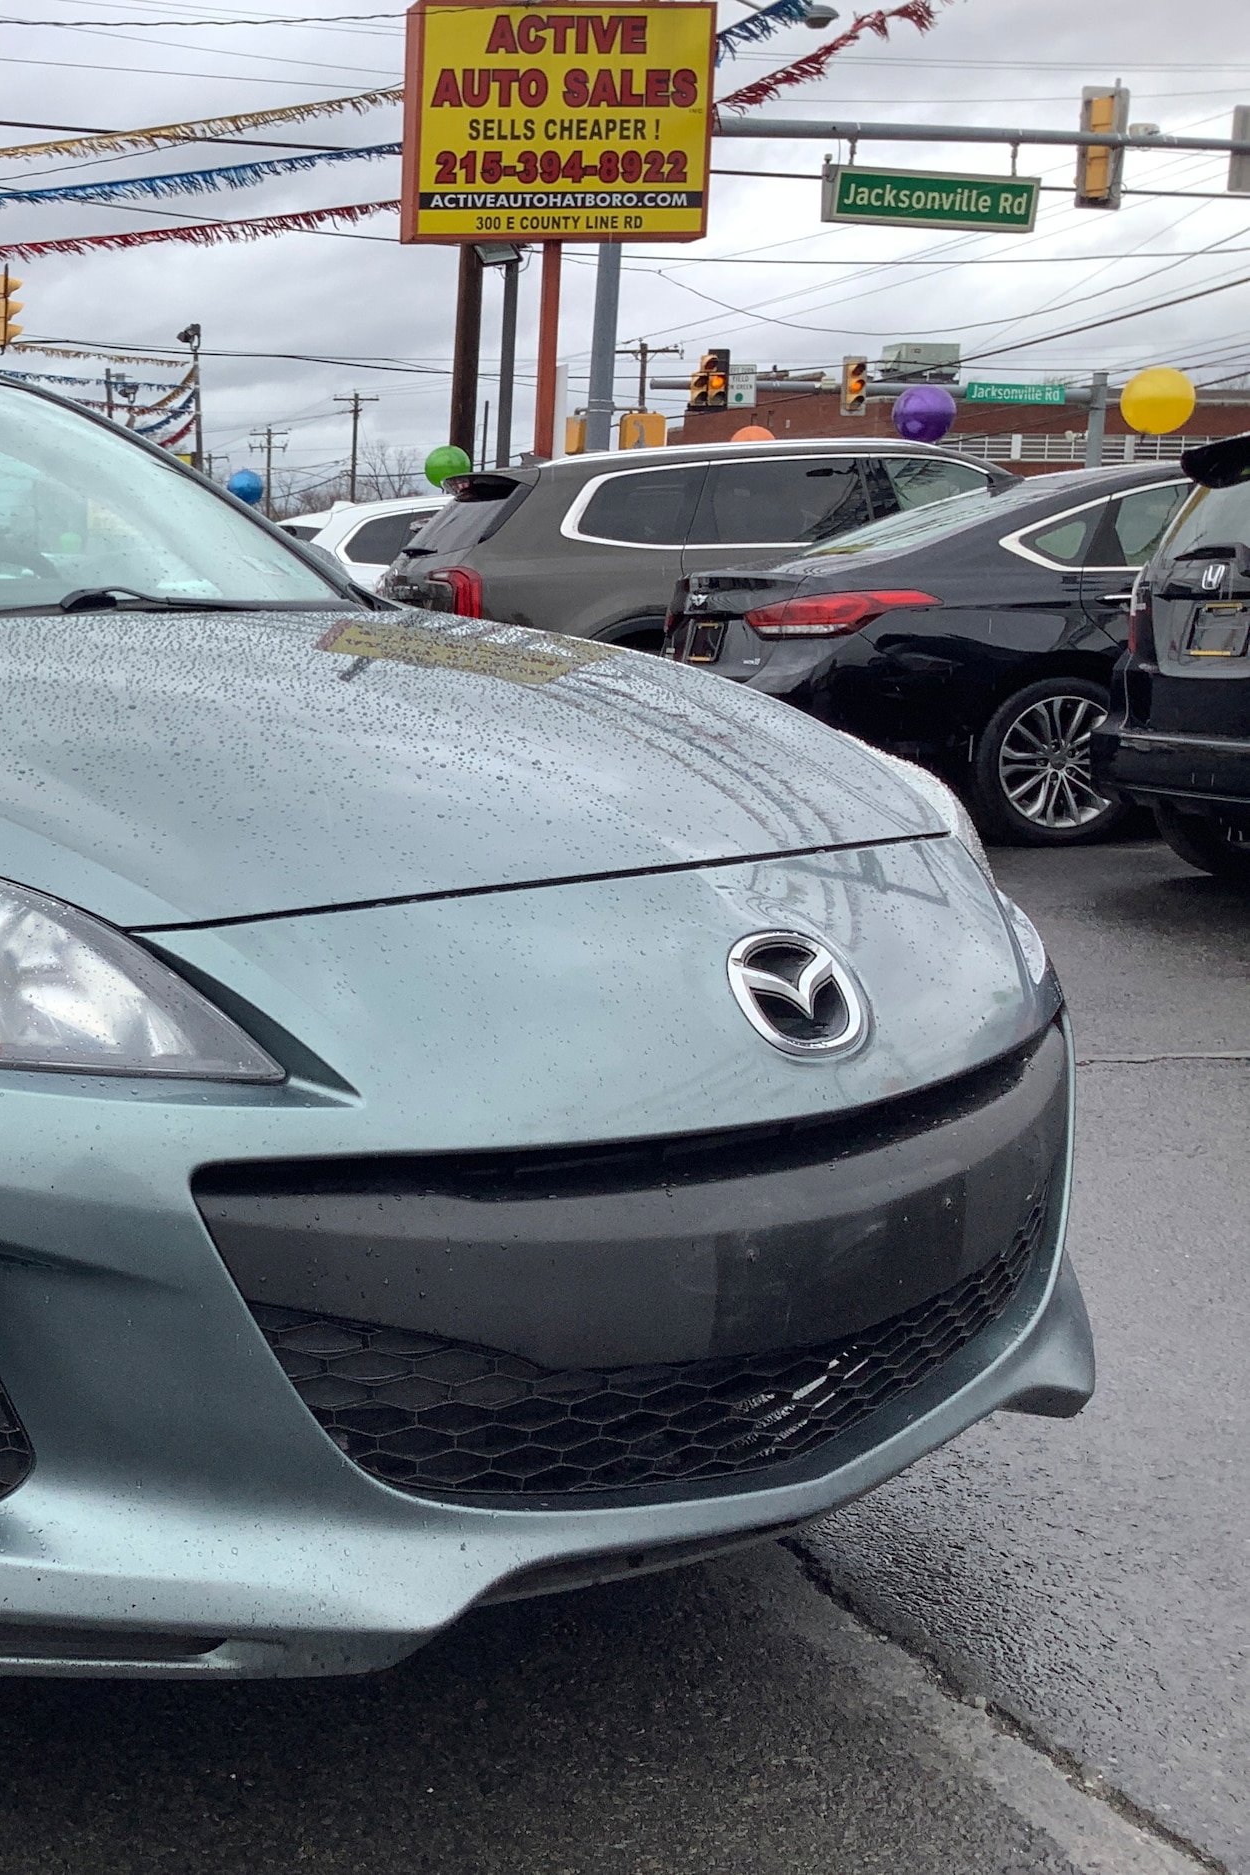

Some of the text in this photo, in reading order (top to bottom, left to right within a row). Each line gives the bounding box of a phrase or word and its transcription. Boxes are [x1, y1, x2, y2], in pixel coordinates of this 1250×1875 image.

[485, 15, 648, 55] ACTIVE
[430, 68, 698, 108] AUTO SALES
[468, 118, 536, 141] SELLS
[544, 118, 647, 141] CHEAPER
[434, 150, 688, 184] 215-394-8922
[430, 193, 688, 208] ACTIVEAUTOHATBORO.COM
[844, 183, 1028, 216] Jacksonville Rd
[475, 215, 643, 231] 300 E COUNTY LINE RD
[971, 385, 1060, 401] Jacksonville Rd
